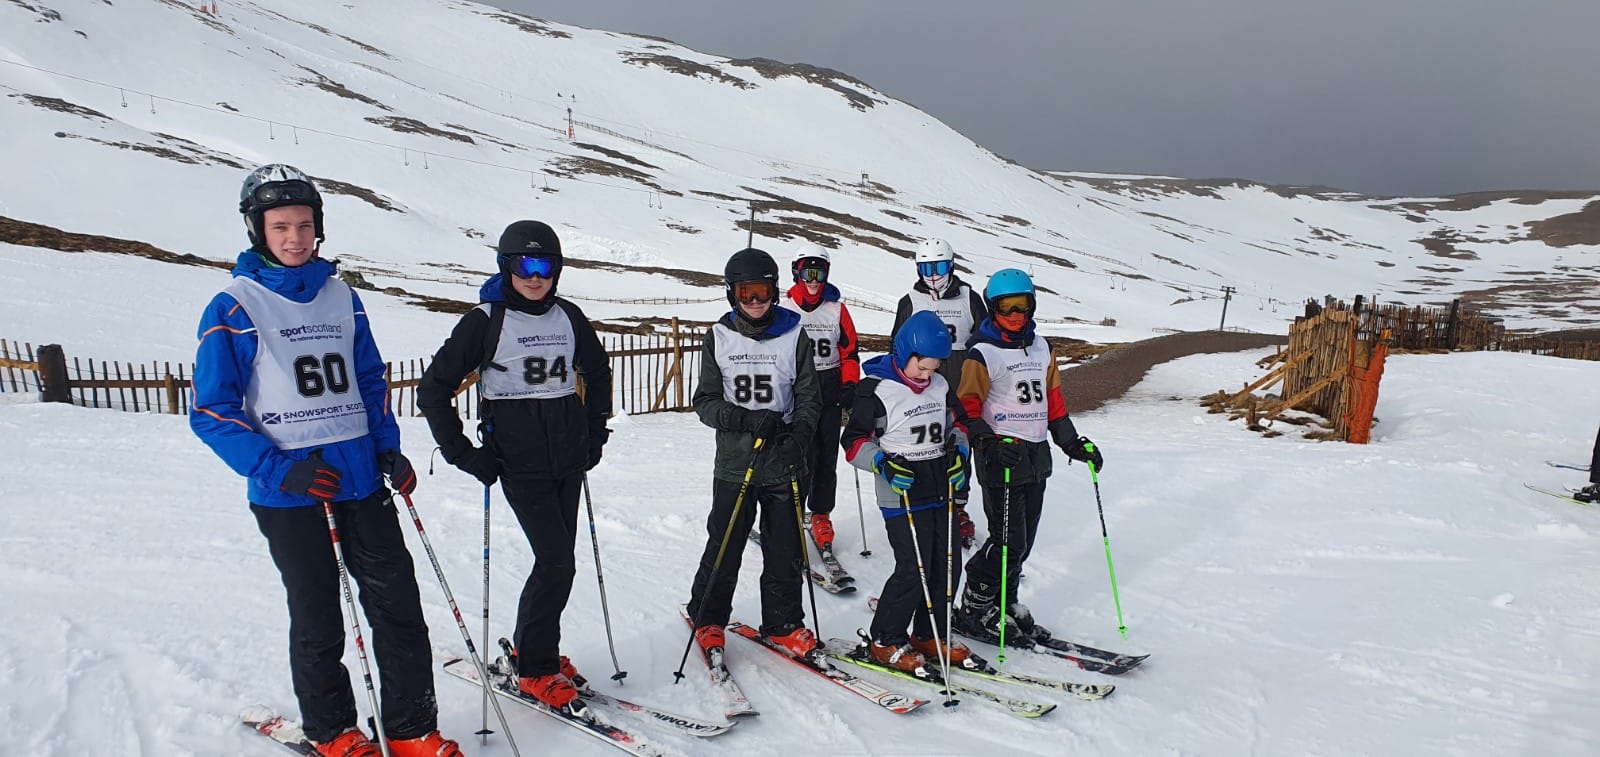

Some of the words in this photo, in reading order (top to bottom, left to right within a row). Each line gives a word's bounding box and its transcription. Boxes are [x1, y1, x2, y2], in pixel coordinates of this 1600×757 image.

[280, 323, 342, 338] sportscotland
[517, 333, 568, 345] sportscotland
[728, 353, 777, 362] sportscotland
[293, 352, 349, 398] 60
[523, 355, 568, 385] 84
[734, 374, 774, 404] 85
[1016, 380, 1043, 405] 35
[283, 405, 343, 420] SNOWSPORT
[910, 422, 942, 445] 78
